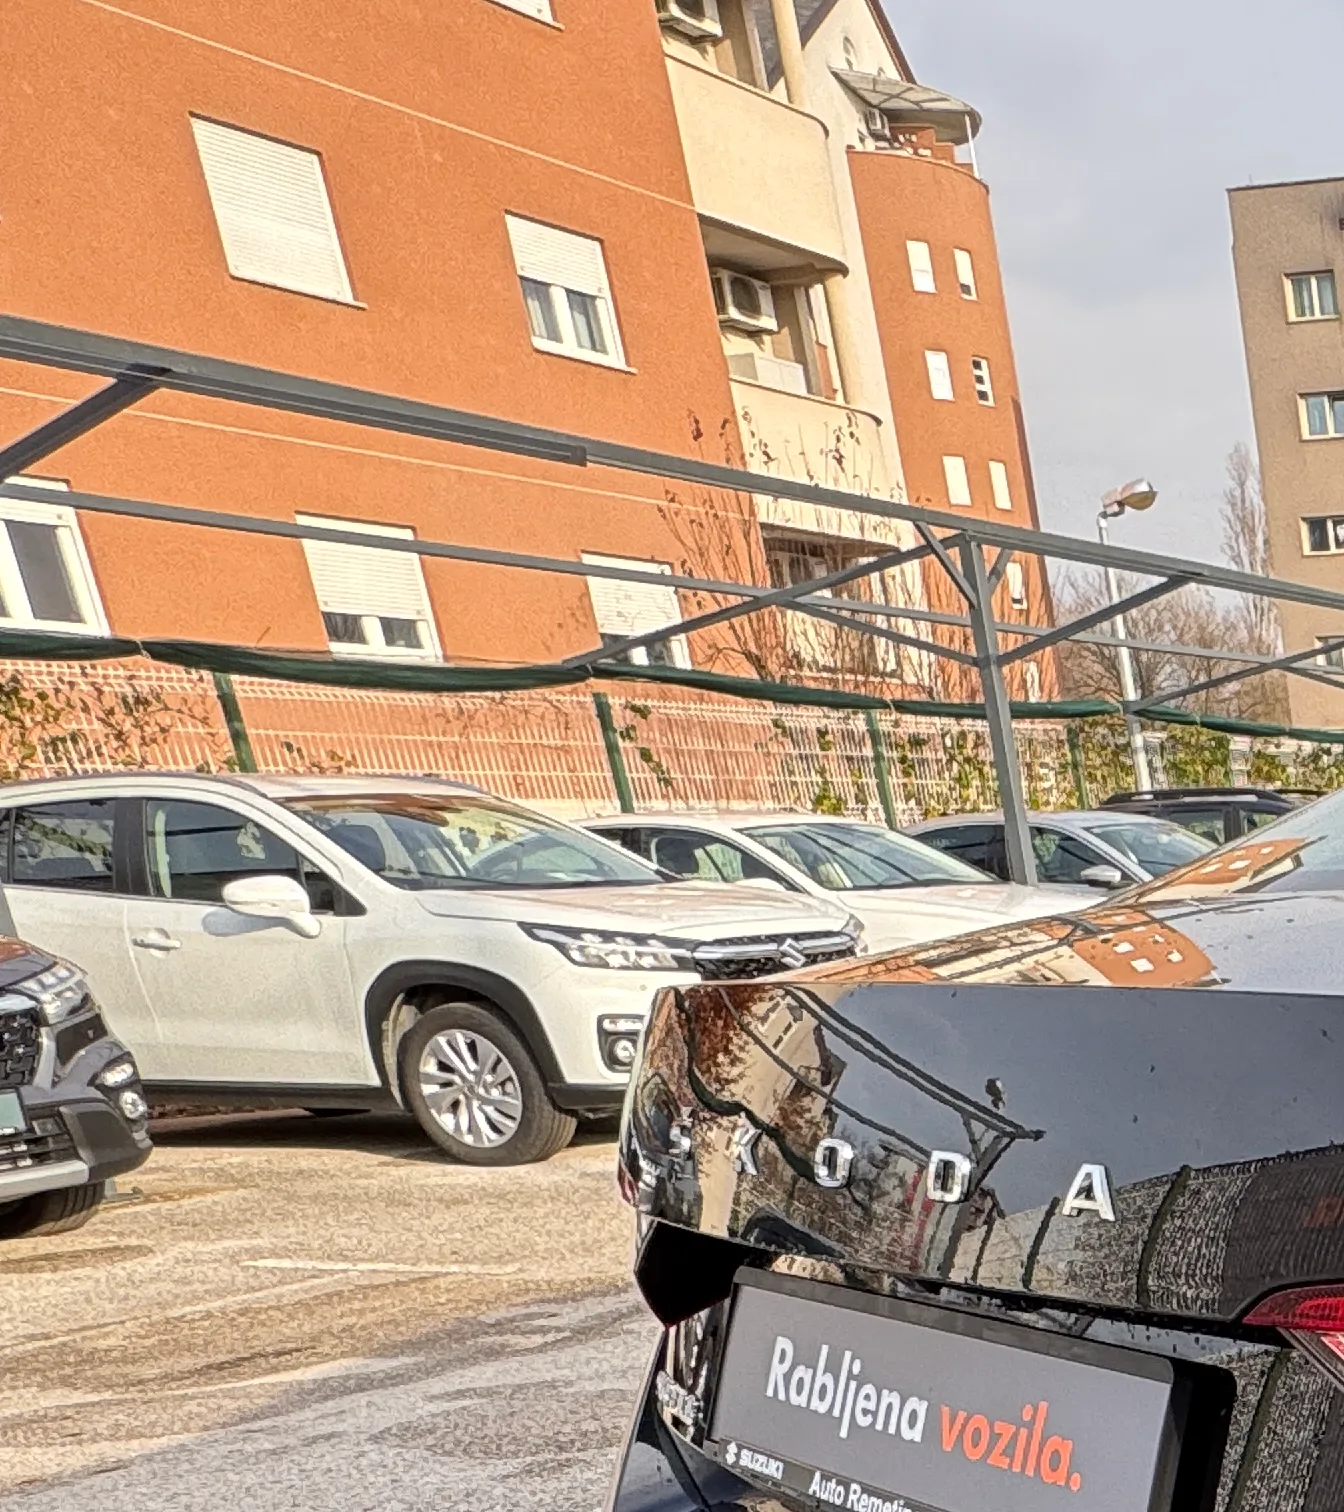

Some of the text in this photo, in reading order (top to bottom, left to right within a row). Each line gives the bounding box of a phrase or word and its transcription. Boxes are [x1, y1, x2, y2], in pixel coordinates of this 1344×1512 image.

[765, 1335, 930, 1443] Rabljena
[940, 1400, 1082, 1492] vozila.
[739, 1448, 784, 1480] SUZUKI
[808, 1470, 845, 1507] Auto
